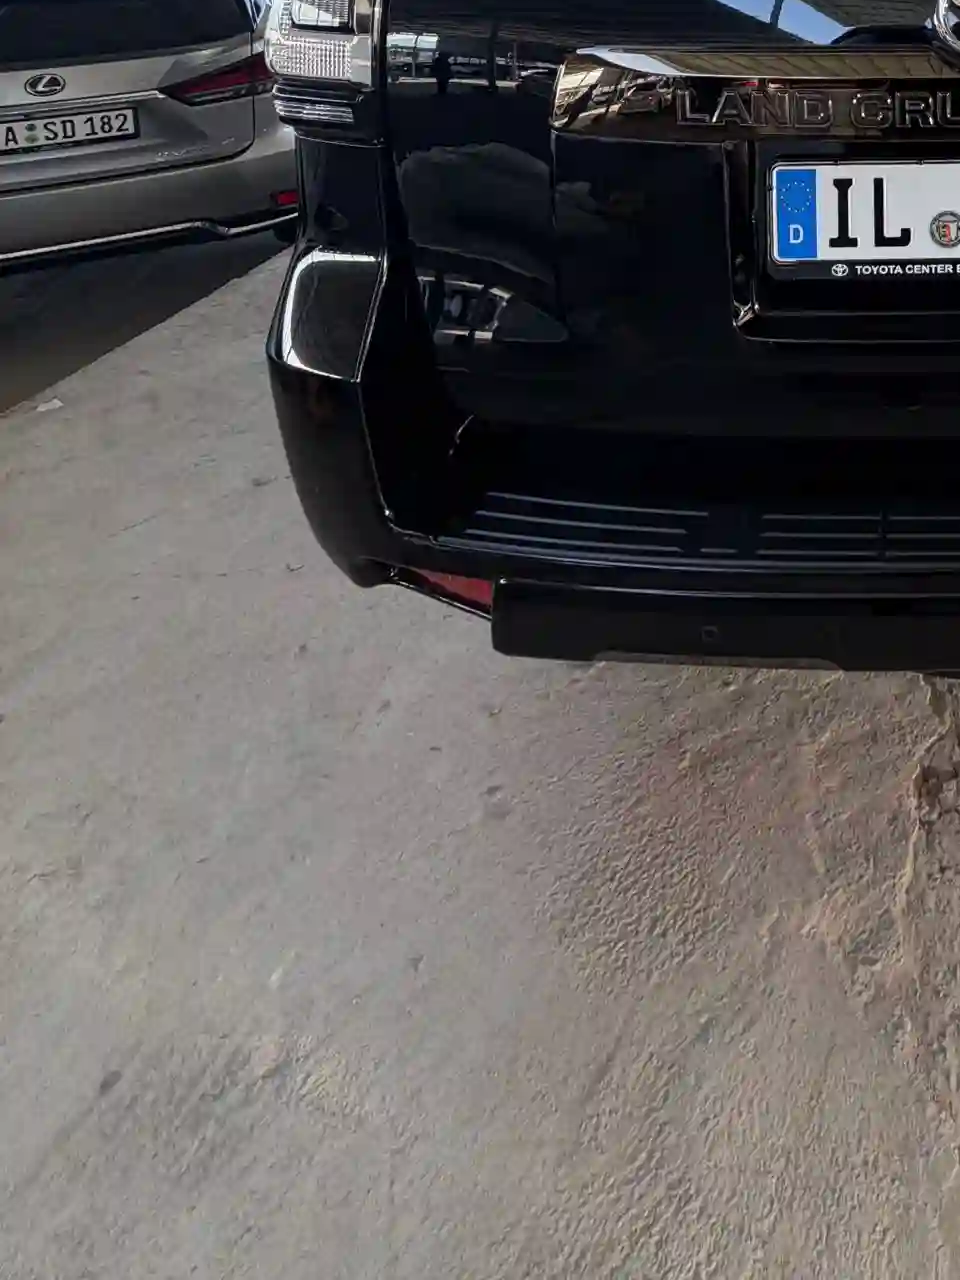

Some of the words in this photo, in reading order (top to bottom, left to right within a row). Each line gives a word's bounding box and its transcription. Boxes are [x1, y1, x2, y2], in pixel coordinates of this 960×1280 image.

[676, 89, 834, 129] LAND
[4, 126, 20, 147] A
[42, 120, 77, 141] SD
[83, 113, 130, 137] 182
[828, 176, 913, 248] IL
[788, 223, 804, 245] D
[854, 264, 904, 276] TOYOTA
[905, 263, 954, 275] CENTER
